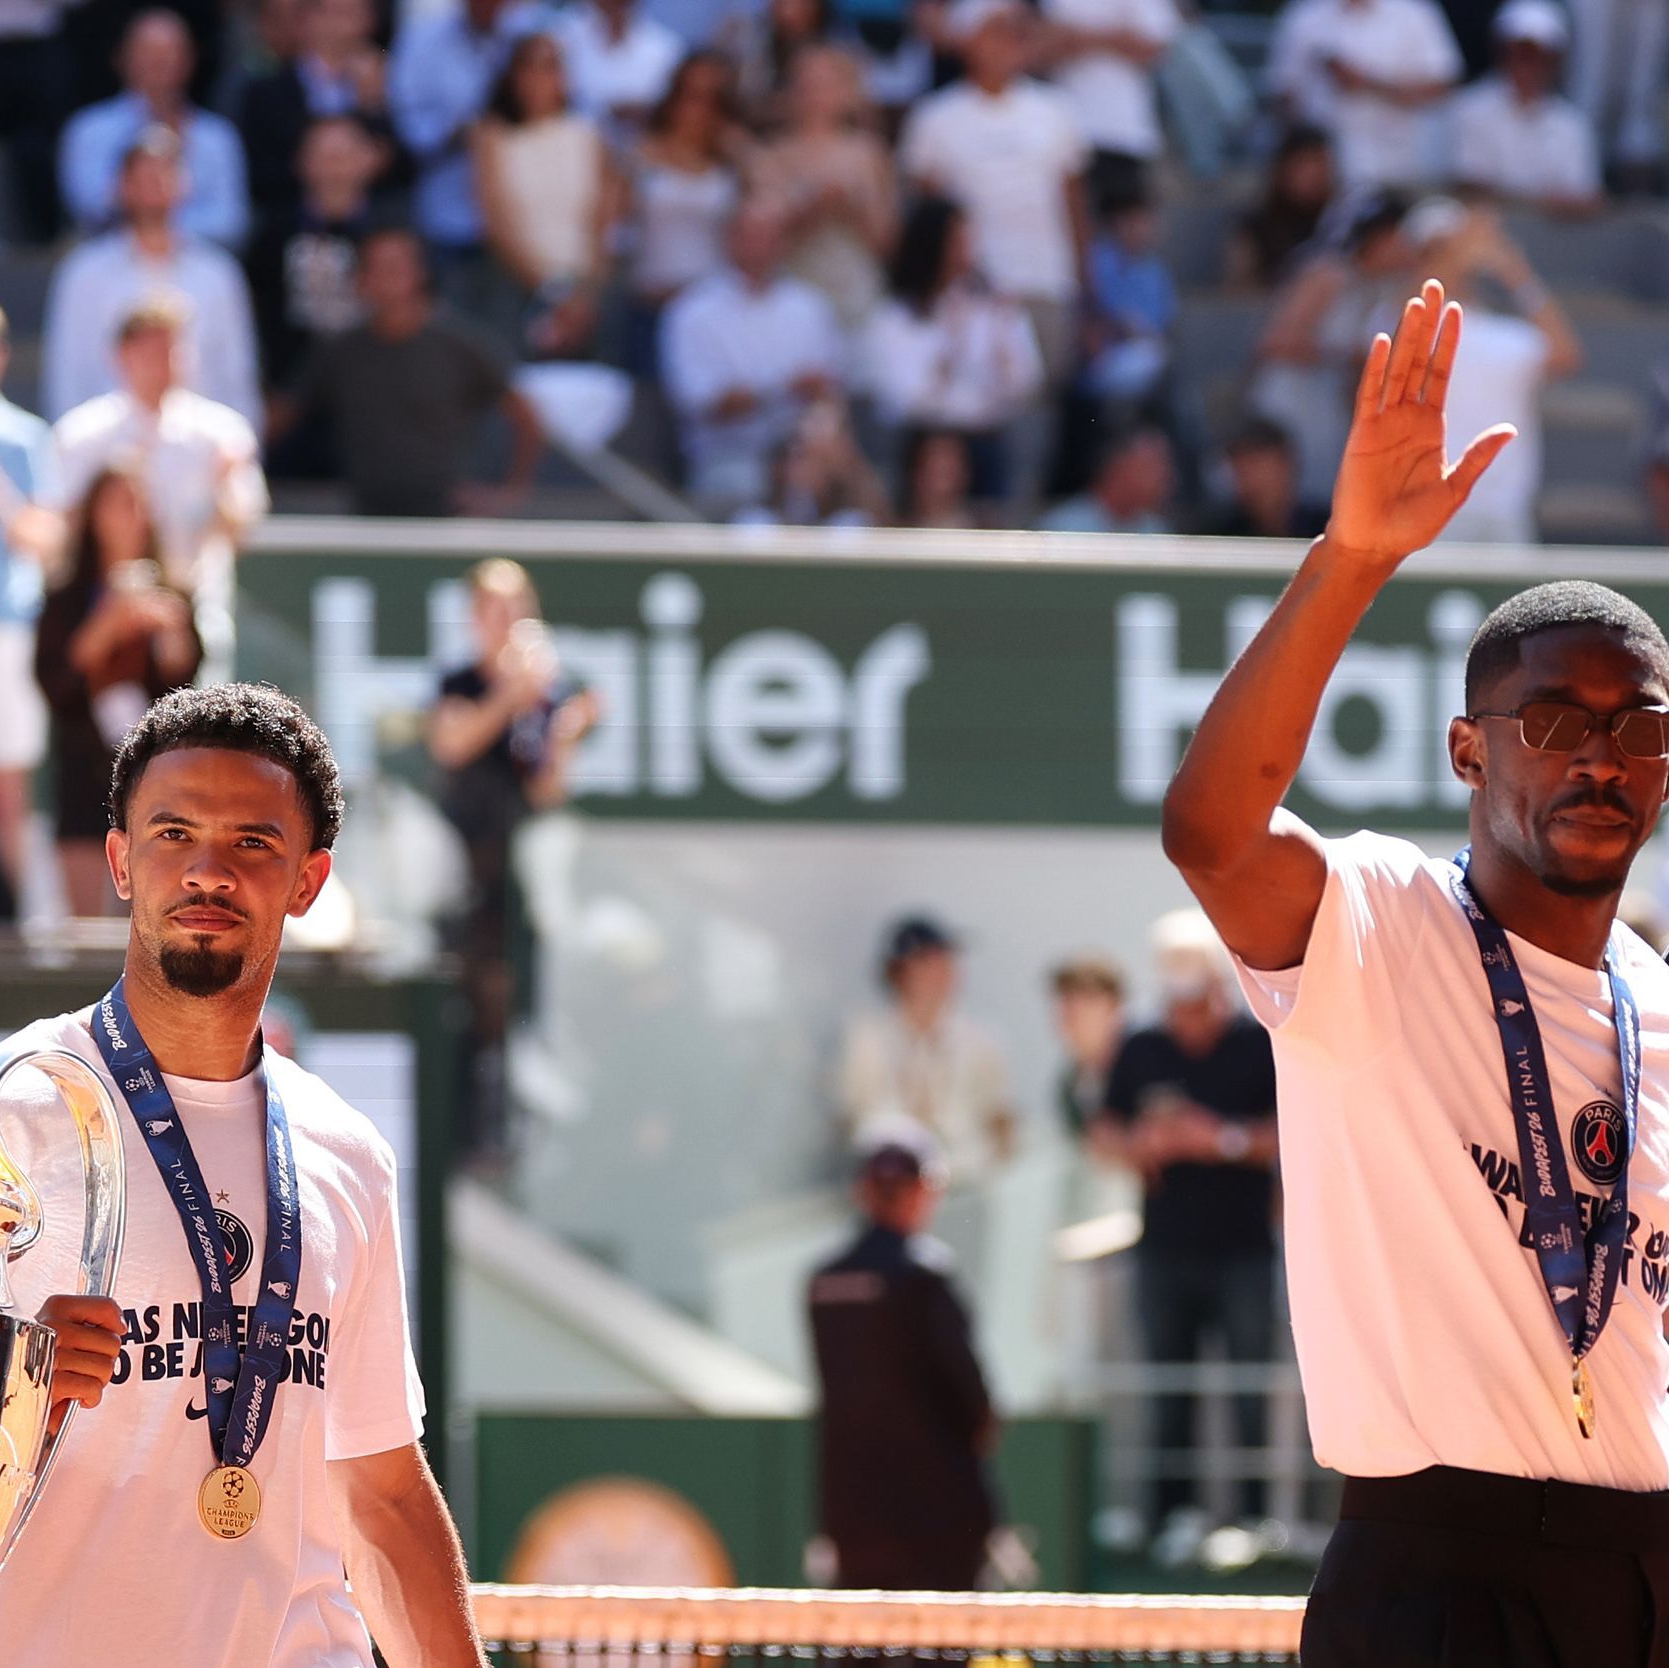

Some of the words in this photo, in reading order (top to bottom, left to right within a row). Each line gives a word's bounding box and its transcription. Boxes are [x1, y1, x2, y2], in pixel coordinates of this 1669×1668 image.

[1516, 1045, 1538, 1107] FINAL
[1585, 1107, 1622, 1132] PARIS
[170, 1158, 200, 1211] FINAL
[1530, 1127, 1557, 1198] BUDAPEST
[280, 1200, 292, 1252] FINAL
[197, 1230, 223, 1294] BUDAPEST
[121, 1305, 161, 1346] AS
[142, 1342, 185, 1382] BE
[244, 1374, 267, 1441] BUDAPEST
[206, 1507, 255, 1521] CHAMPIONS
[213, 1516, 245, 1529] LEAGUE
